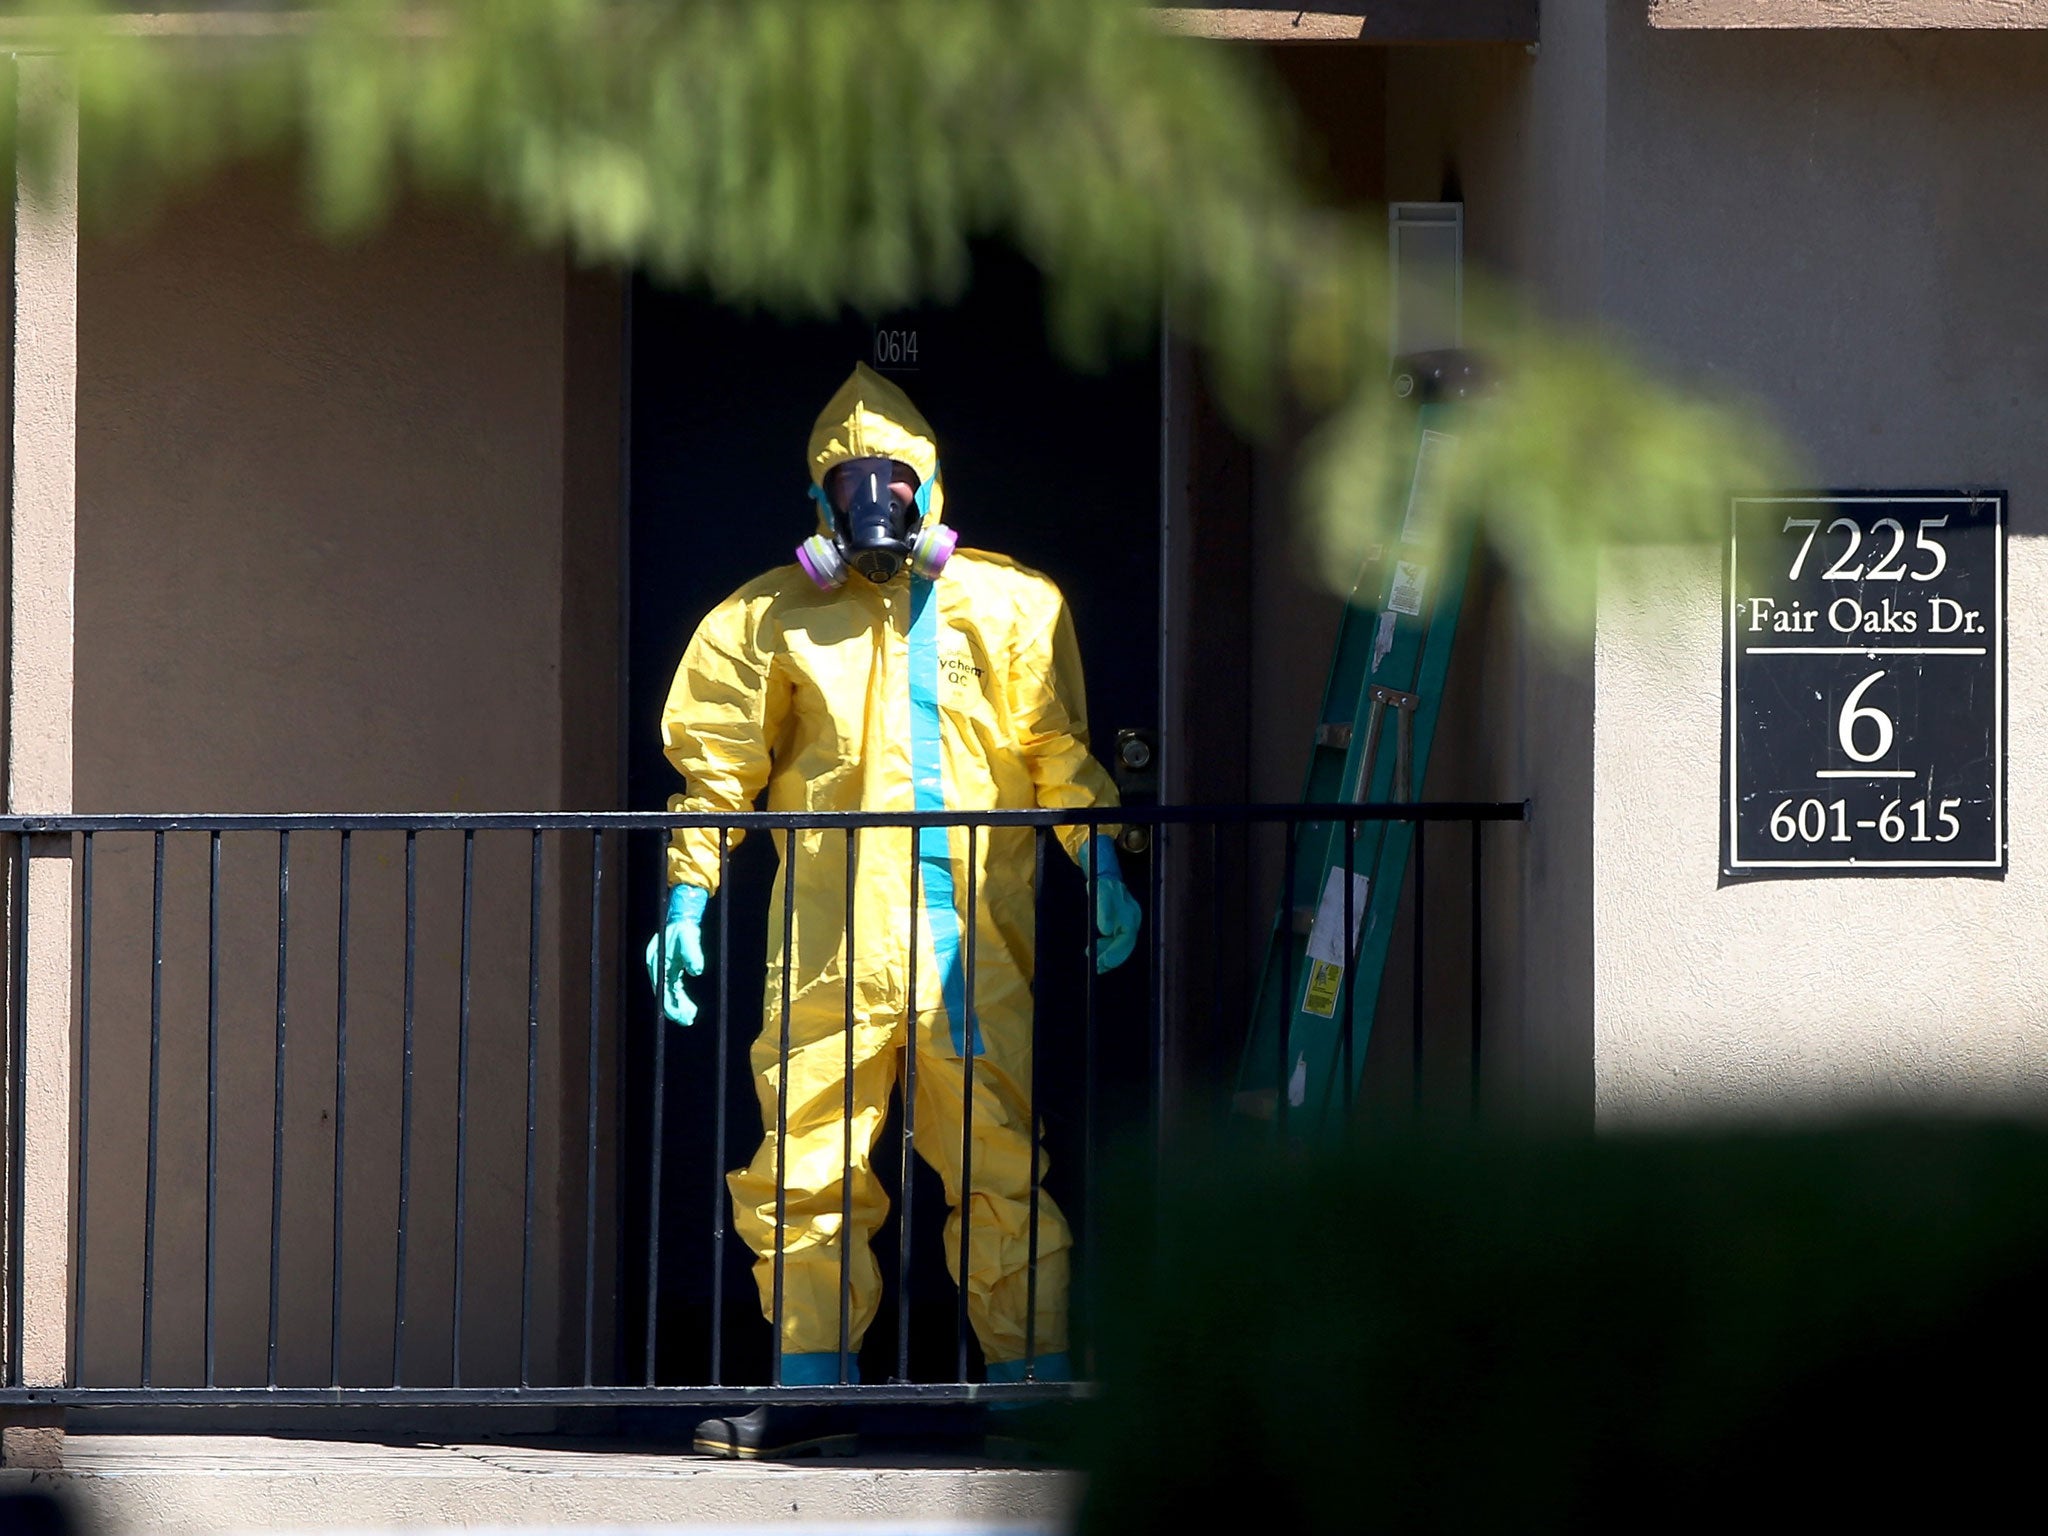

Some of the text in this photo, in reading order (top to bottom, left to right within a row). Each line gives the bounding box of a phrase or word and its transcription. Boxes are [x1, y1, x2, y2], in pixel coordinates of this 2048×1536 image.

[877, 330, 919, 362] 0614
[1782, 514, 1950, 582] 7225
[1748, 597, 1986, 634] Fair Oaks Dr.
[938, 656, 982, 678] ychem
[948, 671, 968, 687] QC
[1838, 670, 1894, 764] 6
[1769, 797, 1962, 844] 601-615
